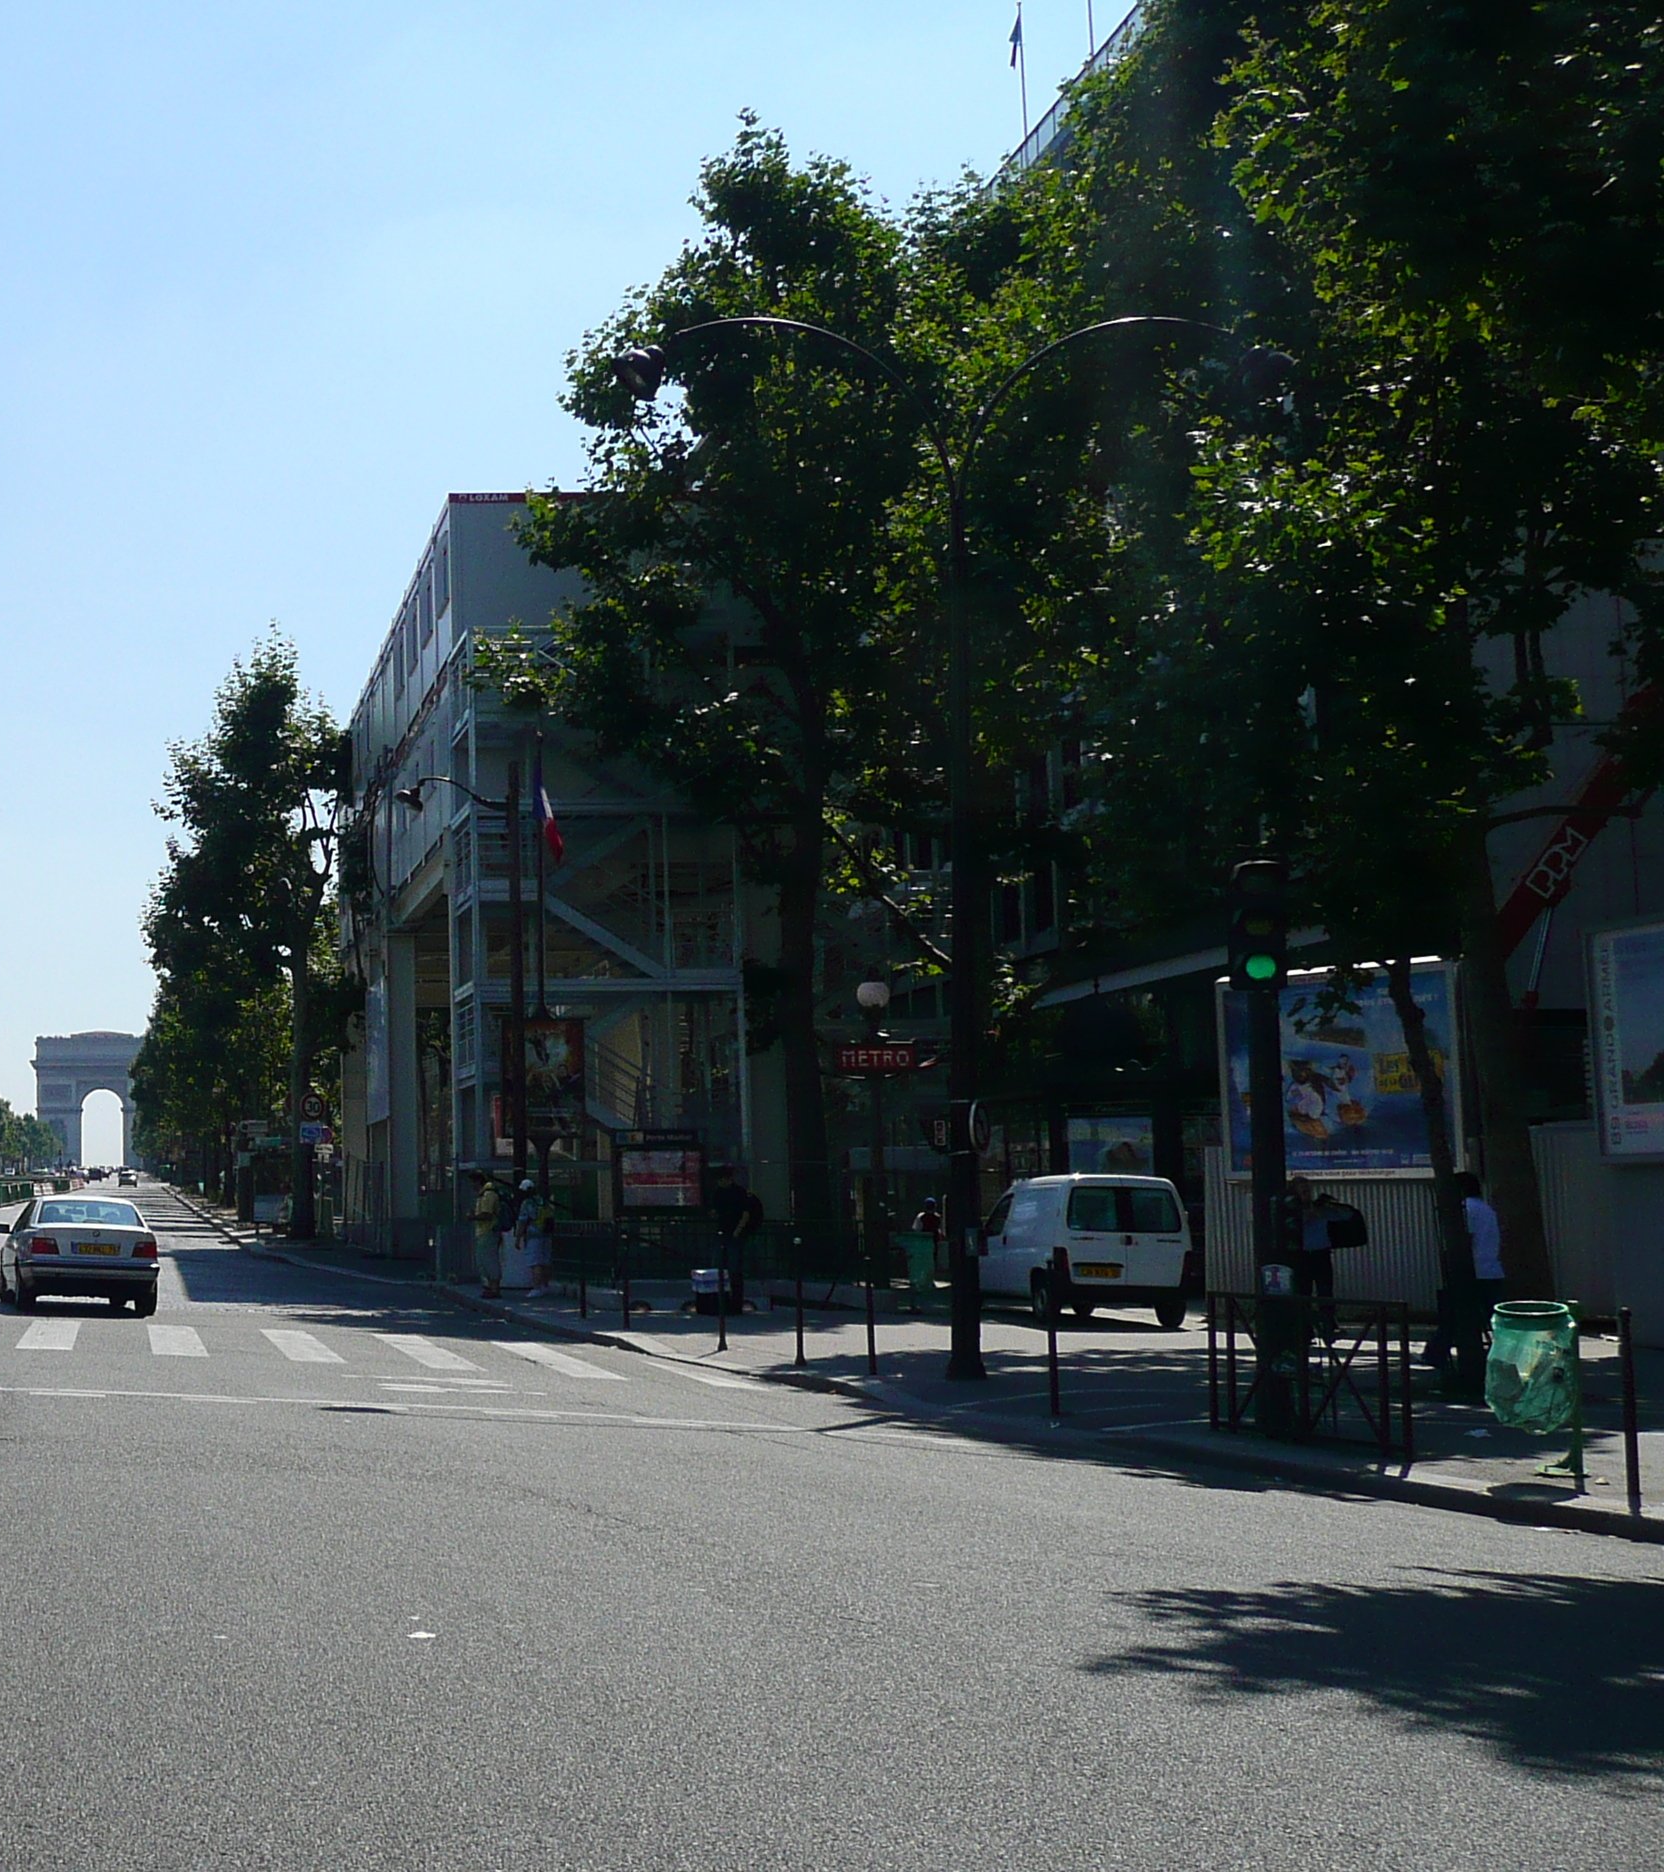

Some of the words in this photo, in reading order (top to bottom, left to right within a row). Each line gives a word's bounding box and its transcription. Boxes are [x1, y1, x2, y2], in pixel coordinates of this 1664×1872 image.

[469, 494, 509, 502] LOXAM
[1525, 825, 1589, 899] PPM
[841, 1050, 909, 1067] METRO
[306, 1101, 320, 1113] 30
